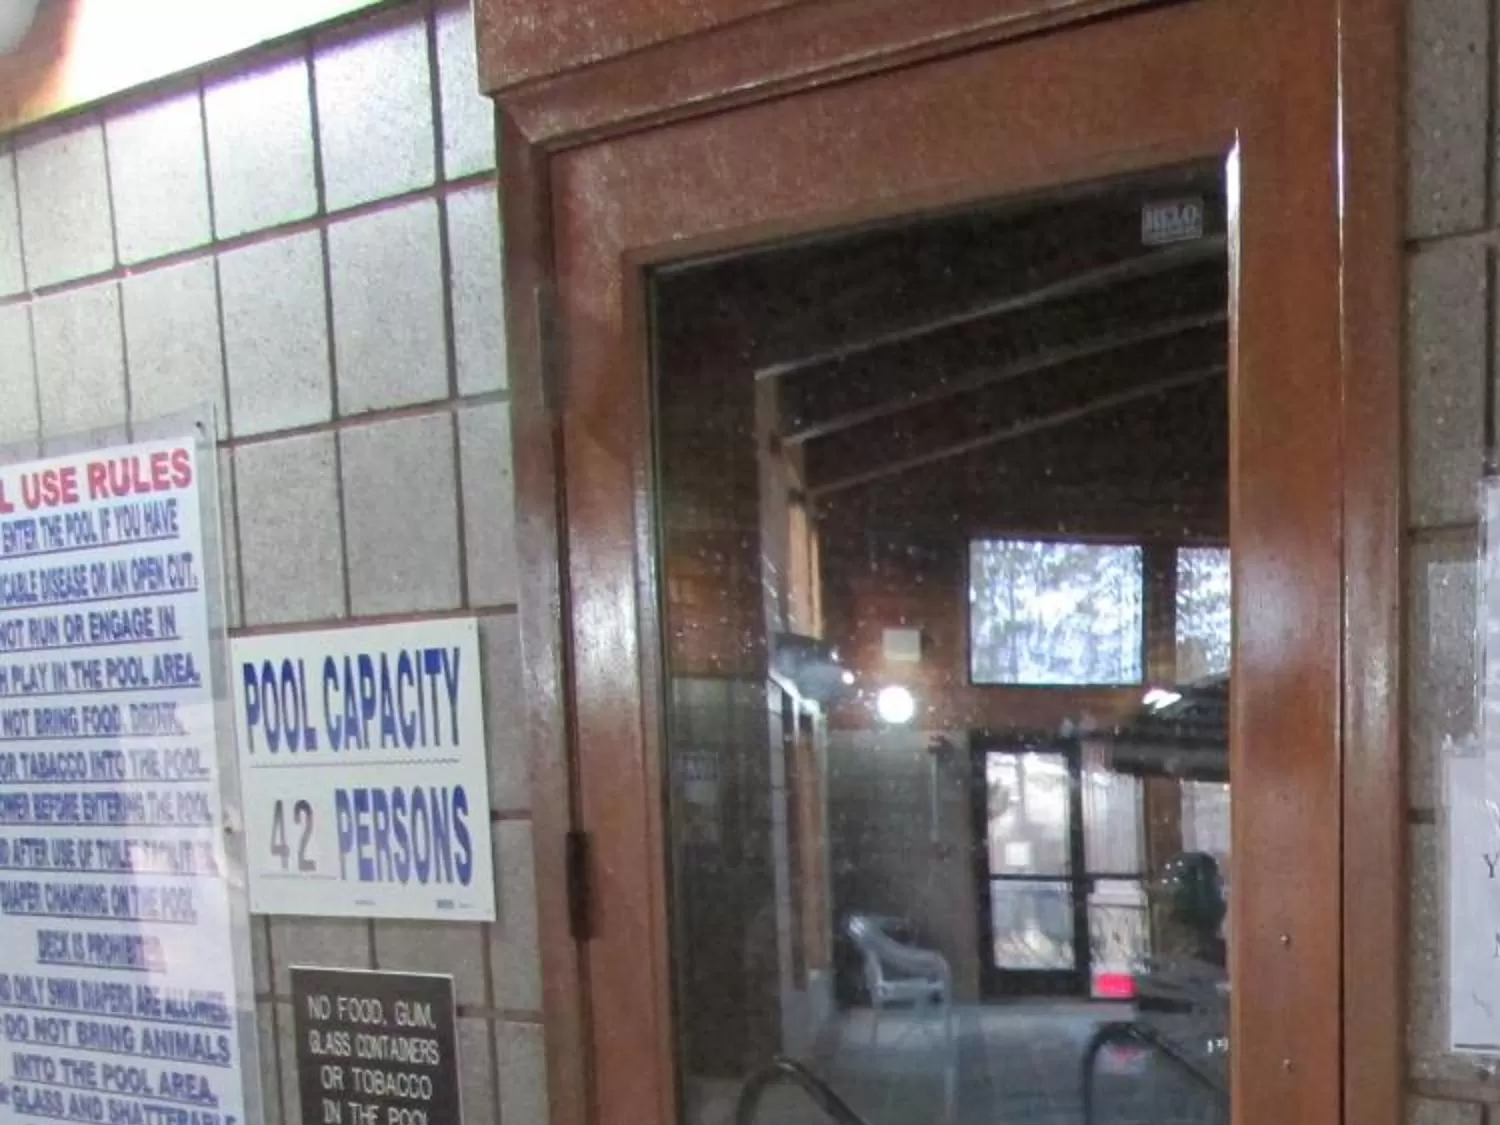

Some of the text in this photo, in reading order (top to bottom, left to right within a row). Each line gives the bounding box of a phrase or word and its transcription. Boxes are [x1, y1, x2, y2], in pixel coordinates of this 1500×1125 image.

[21, 466, 80, 510] USE
[87, 448, 192, 500] RULES
[2, 498, 178, 553] ENTER THE POOL IF YOU HAVE
[40, 563, 89, 600] DISEASE
[90, 561, 109, 596] OR
[111, 559, 129, 592] AN
[131, 555, 165, 590] OPEN
[28, 615, 61, 646] RUN
[63, 613, 86, 643] OR
[88, 605, 154, 641] ENGAGE
[157, 604, 177, 637] IN
[11, 662, 48, 692] PLAY
[51, 660, 69, 690] IN
[70, 658, 103, 688] THE
[105, 655, 149, 687] POOL
[243, 646, 461, 754] POOL CAPACITY
[34, 706, 80, 736] BRING
[89, 749, 127, 778] INTO
[129, 748, 161, 778] THE
[270, 783, 473, 888] 42 PERSONS
[307, 995, 331, 1020] NO
[4, 1013, 231, 1064] DO NOT BRING ANIMALS
[308, 1029, 441, 1065] GLASS CONTAINERS
[12, 1051, 56, 1082] INTO
[60, 1057, 97, 1087] THE
[102, 1062, 153, 1094] POOL
[320, 1065, 433, 1101] OR TOBACCO
[12, 1084, 65, 1116] GLASS
[69, 1092, 103, 1122] AND
[322, 1098, 342, 1125] IN
